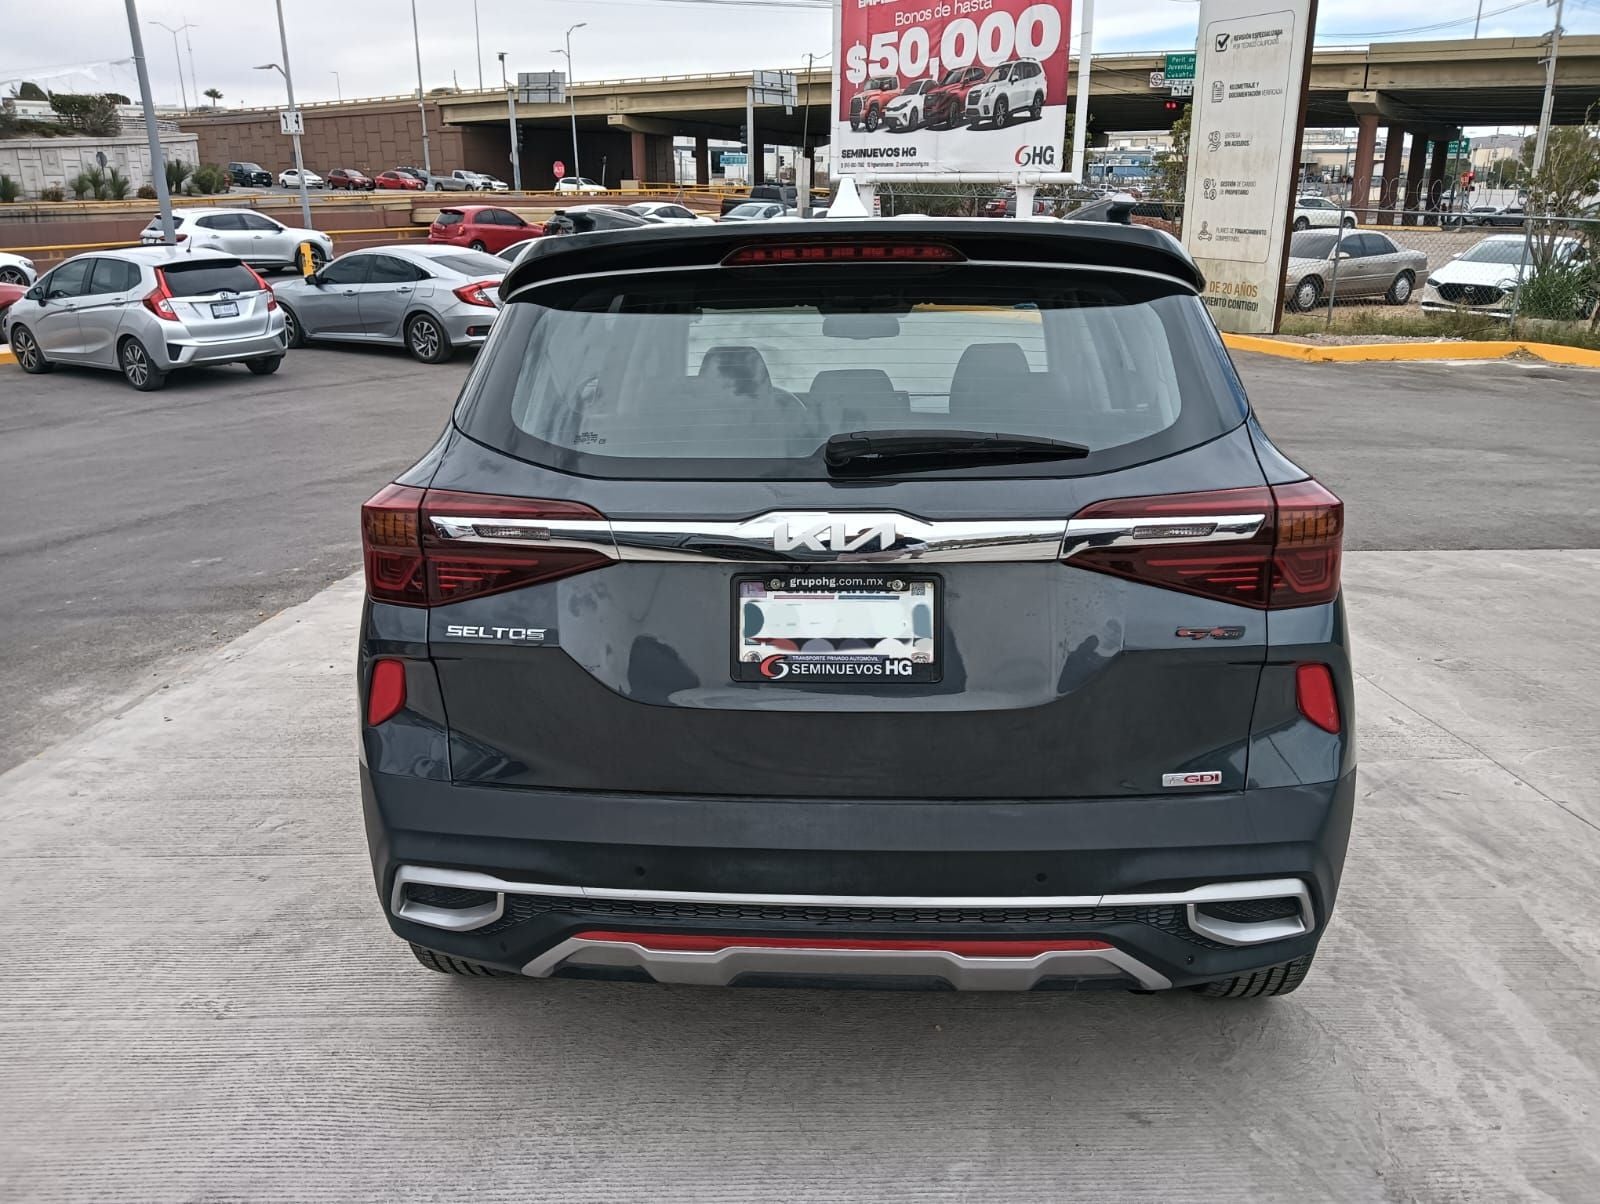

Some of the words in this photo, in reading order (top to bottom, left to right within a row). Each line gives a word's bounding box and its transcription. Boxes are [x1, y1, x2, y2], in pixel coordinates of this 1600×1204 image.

[895, 11, 932, 27] Bonos
[934, 6, 950, 18] de
[954, 0, 993, 16] hasta
[846, 3, 1062, 88] $50,000
[841, 147, 900, 159] SEMINUEVOS
[901, 147, 917, 157] HG
[1031, 145, 1055, 165] HG
[1209, 281, 1220, 293] DE
[1222, 282, 1233, 294] 20
[1234, 282, 1258, 298] AÑOS
[1228, 299, 1258, 312] CONTIGO!
[774, 522, 896, 551] KIA
[790, 577, 883, 588] grupohg.com.mx
[445, 625, 548, 640] SELTOS
[791, 664, 882, 675] SEMINUEVOS
[885, 661, 912, 675] HG
[1184, 773, 1220, 783] GDI
